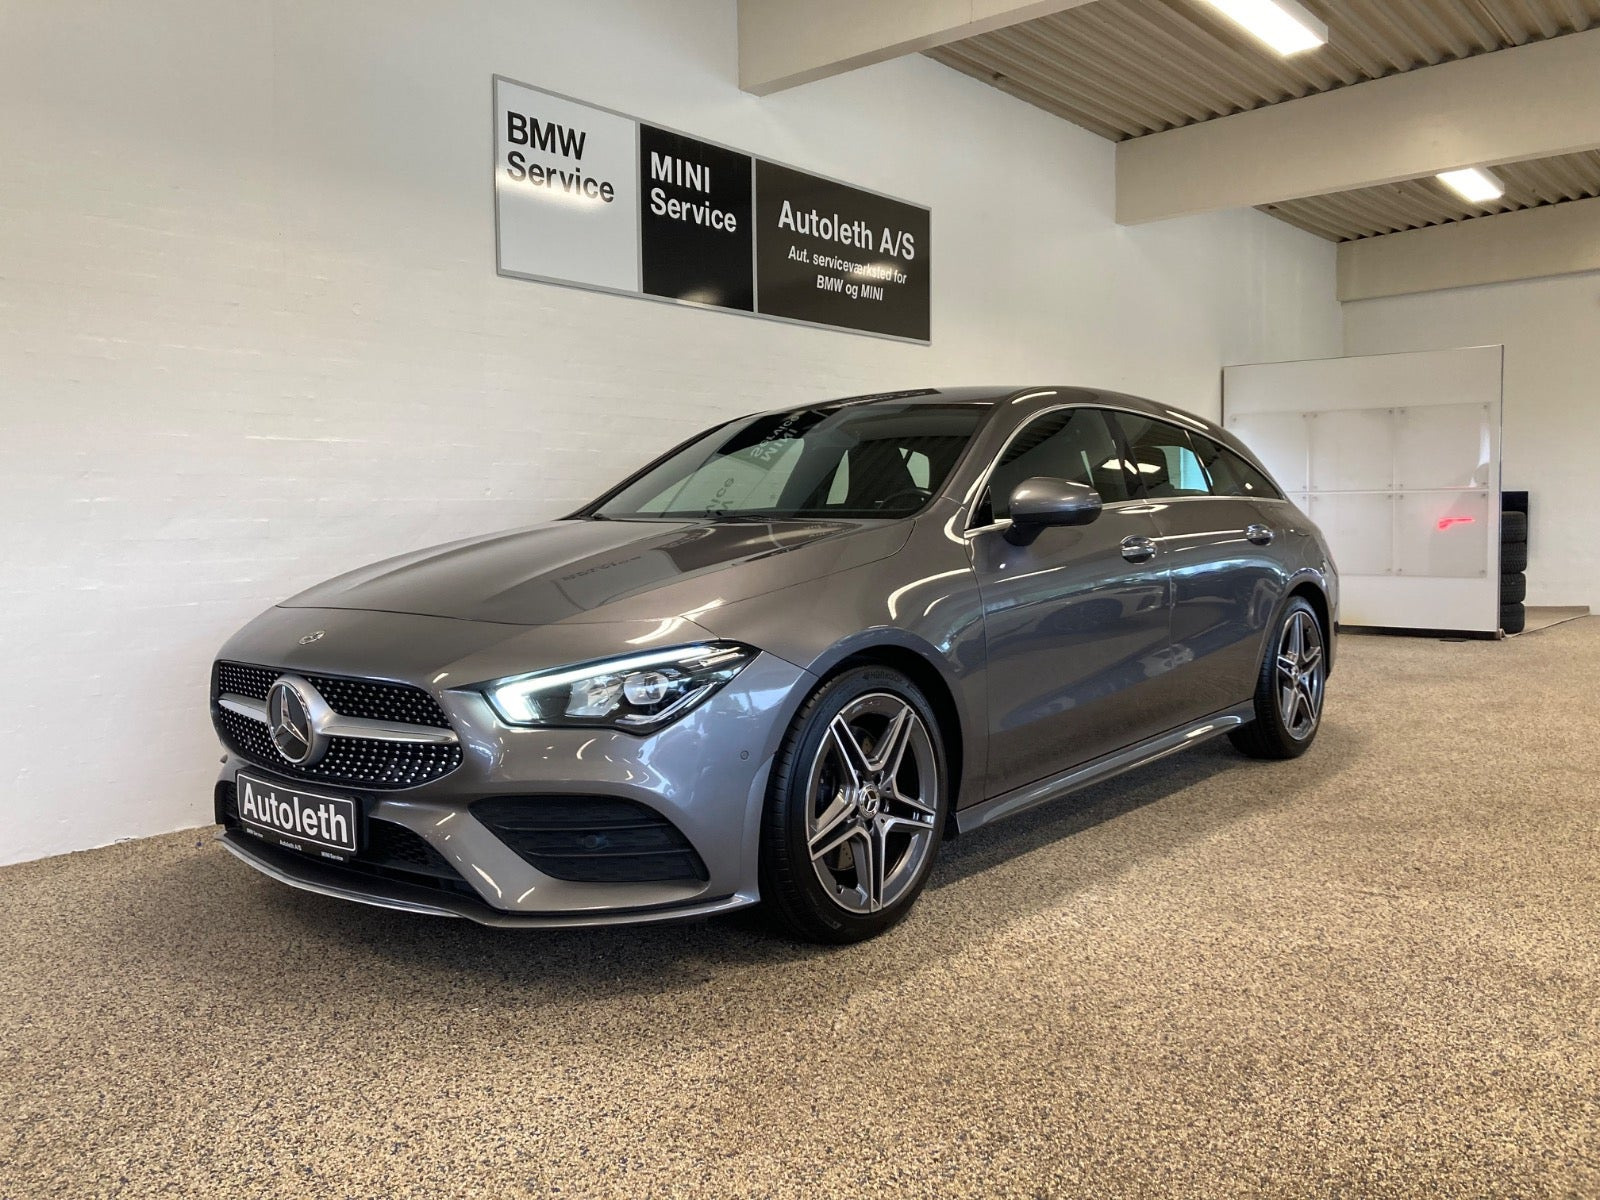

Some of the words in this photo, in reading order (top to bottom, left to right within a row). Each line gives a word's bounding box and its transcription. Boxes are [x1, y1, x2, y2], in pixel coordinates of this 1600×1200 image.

[507, 110, 586, 161] BMW
[506, 150, 614, 203] Service
[651, 151, 710, 194] MINI
[650, 187, 737, 232] Service
[778, 200, 873, 250] Autoleth
[879, 227, 915, 260] A/S
[788, 245, 809, 263] Aut.
[812, 253, 892, 281] serviceværksted
[894, 269, 907, 284] for
[816, 274, 844, 293] BMW
[845, 283, 858, 299] og
[860, 284, 884, 301] MINI
[243, 782, 348, 843] Autoleth
